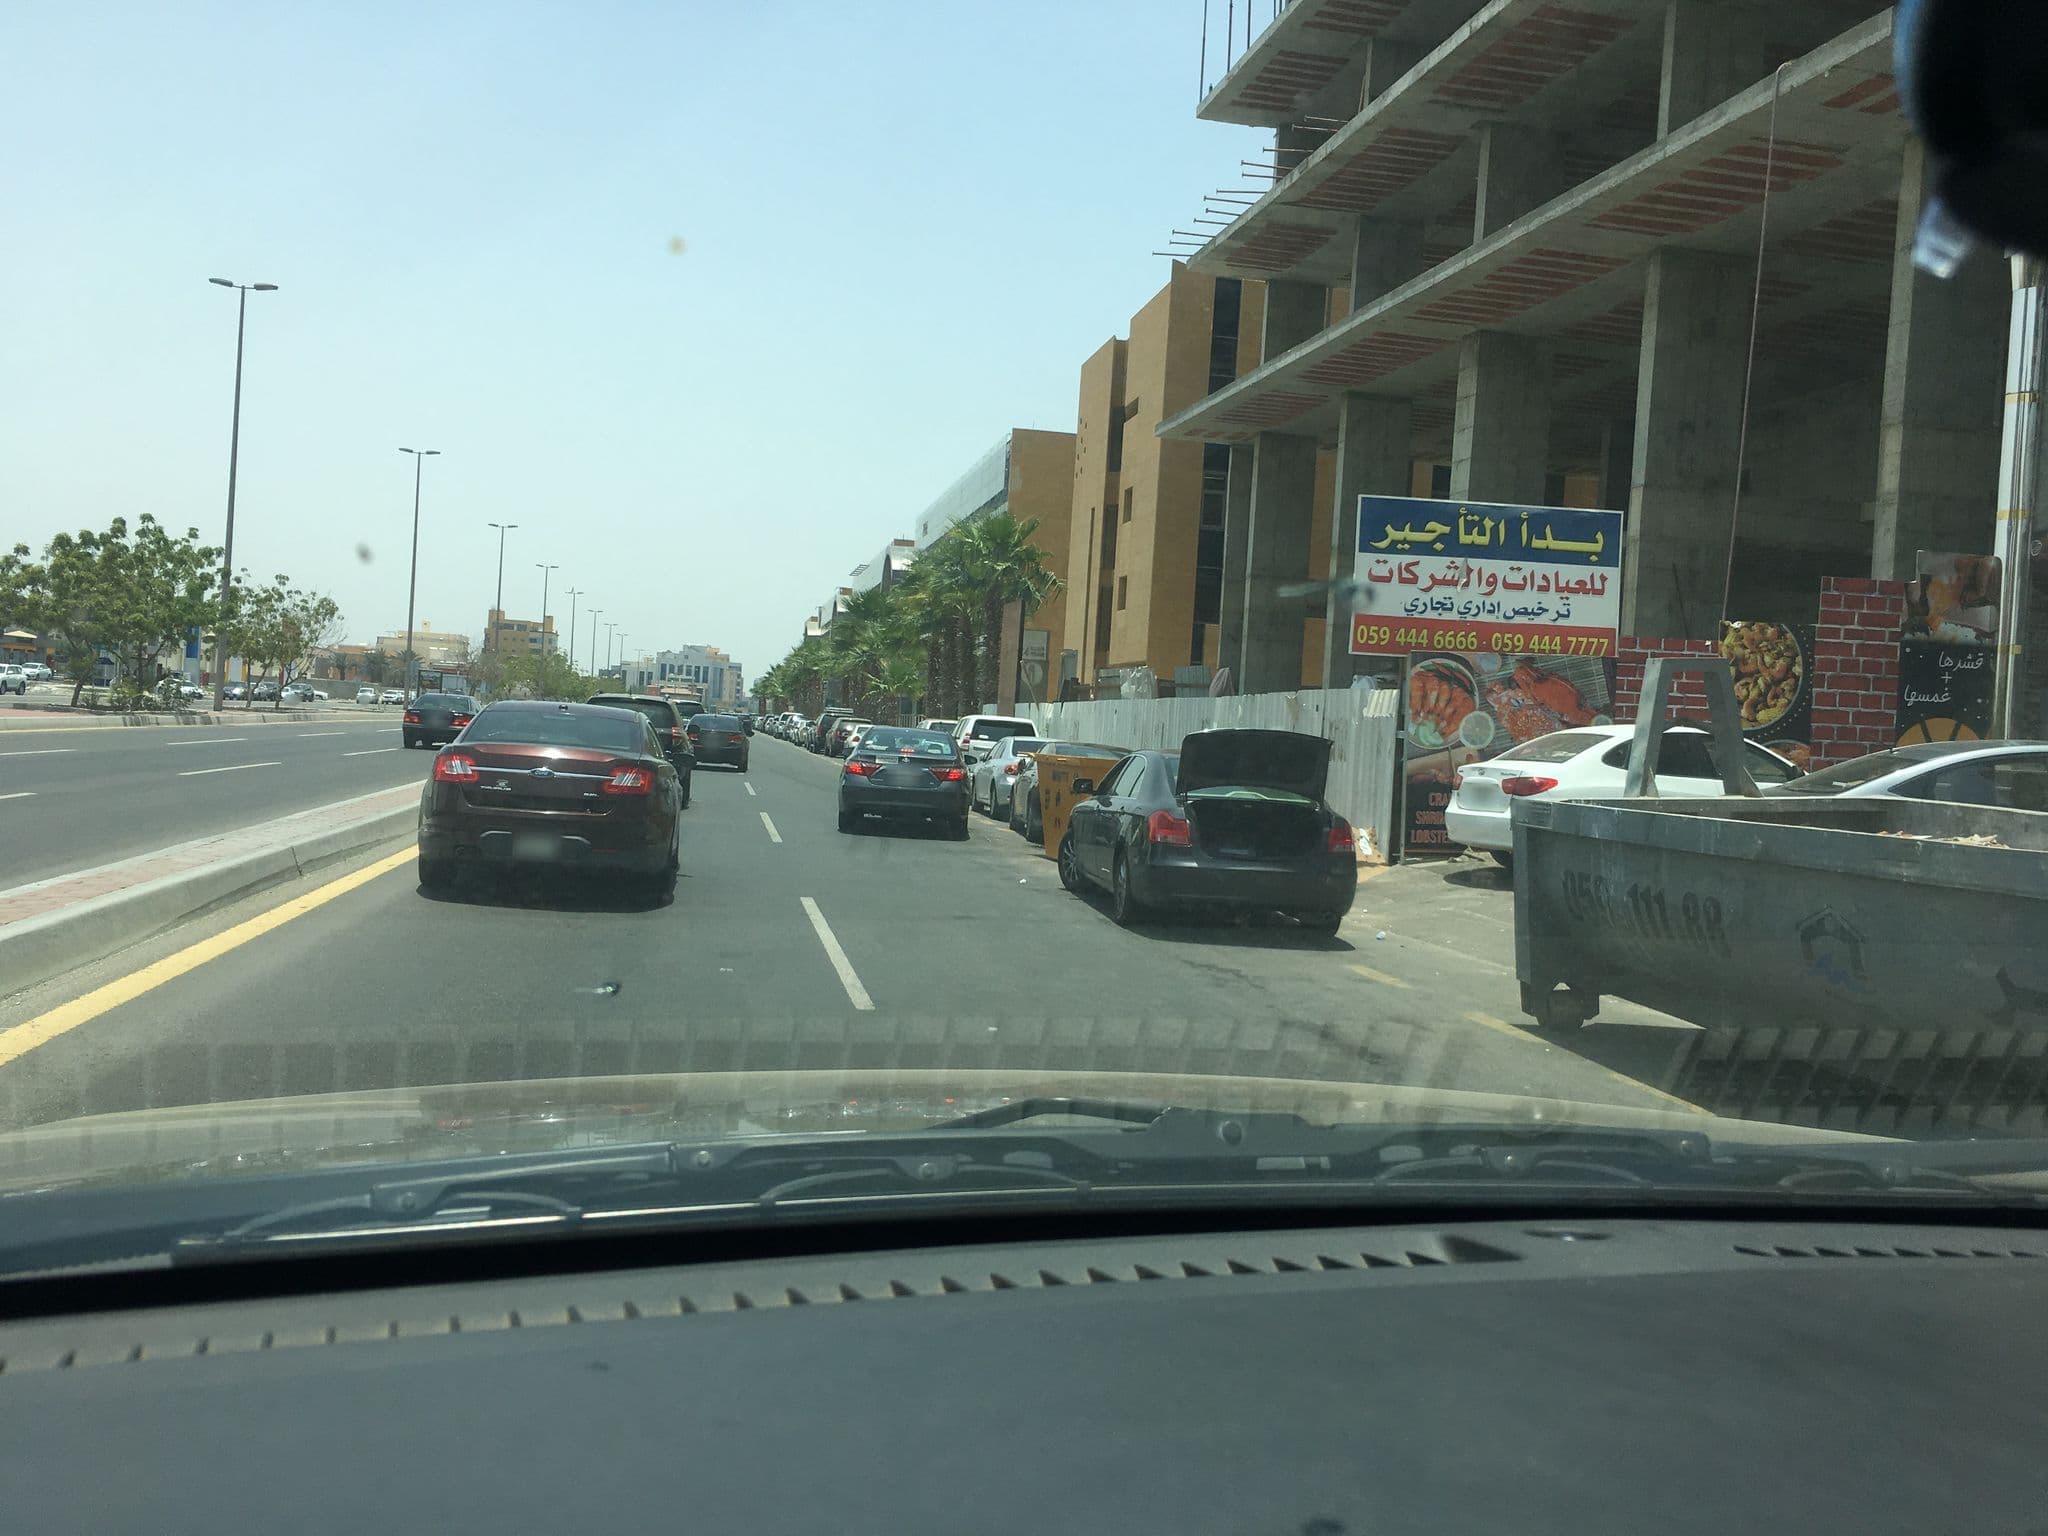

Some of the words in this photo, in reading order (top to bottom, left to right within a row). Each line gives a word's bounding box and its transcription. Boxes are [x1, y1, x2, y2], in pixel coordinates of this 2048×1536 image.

[1368, 506, 1507, 552] التأجير
[1520, 511, 1605, 563] بدأ
[1367, 558, 1499, 597] والشركات
[1502, 565, 1609, 602] للعيادات
[1402, 595, 1455, 616] تجاري
[1456, 599, 1501, 620] إداري
[1502, 601, 1572, 622] ترخيص
[1357, 624, 1391, 646] 059
[1395, 627, 1429, 648] 444
[1433, 630, 1478, 650] 6666
[1491, 632, 1525, 653] 059
[1528, 634, 1562, 654] 444
[1566, 636, 1609, 657] 7777
[1938, 651, 1984, 672] قشرها
[1903, 684, 1952, 707] غمسها
